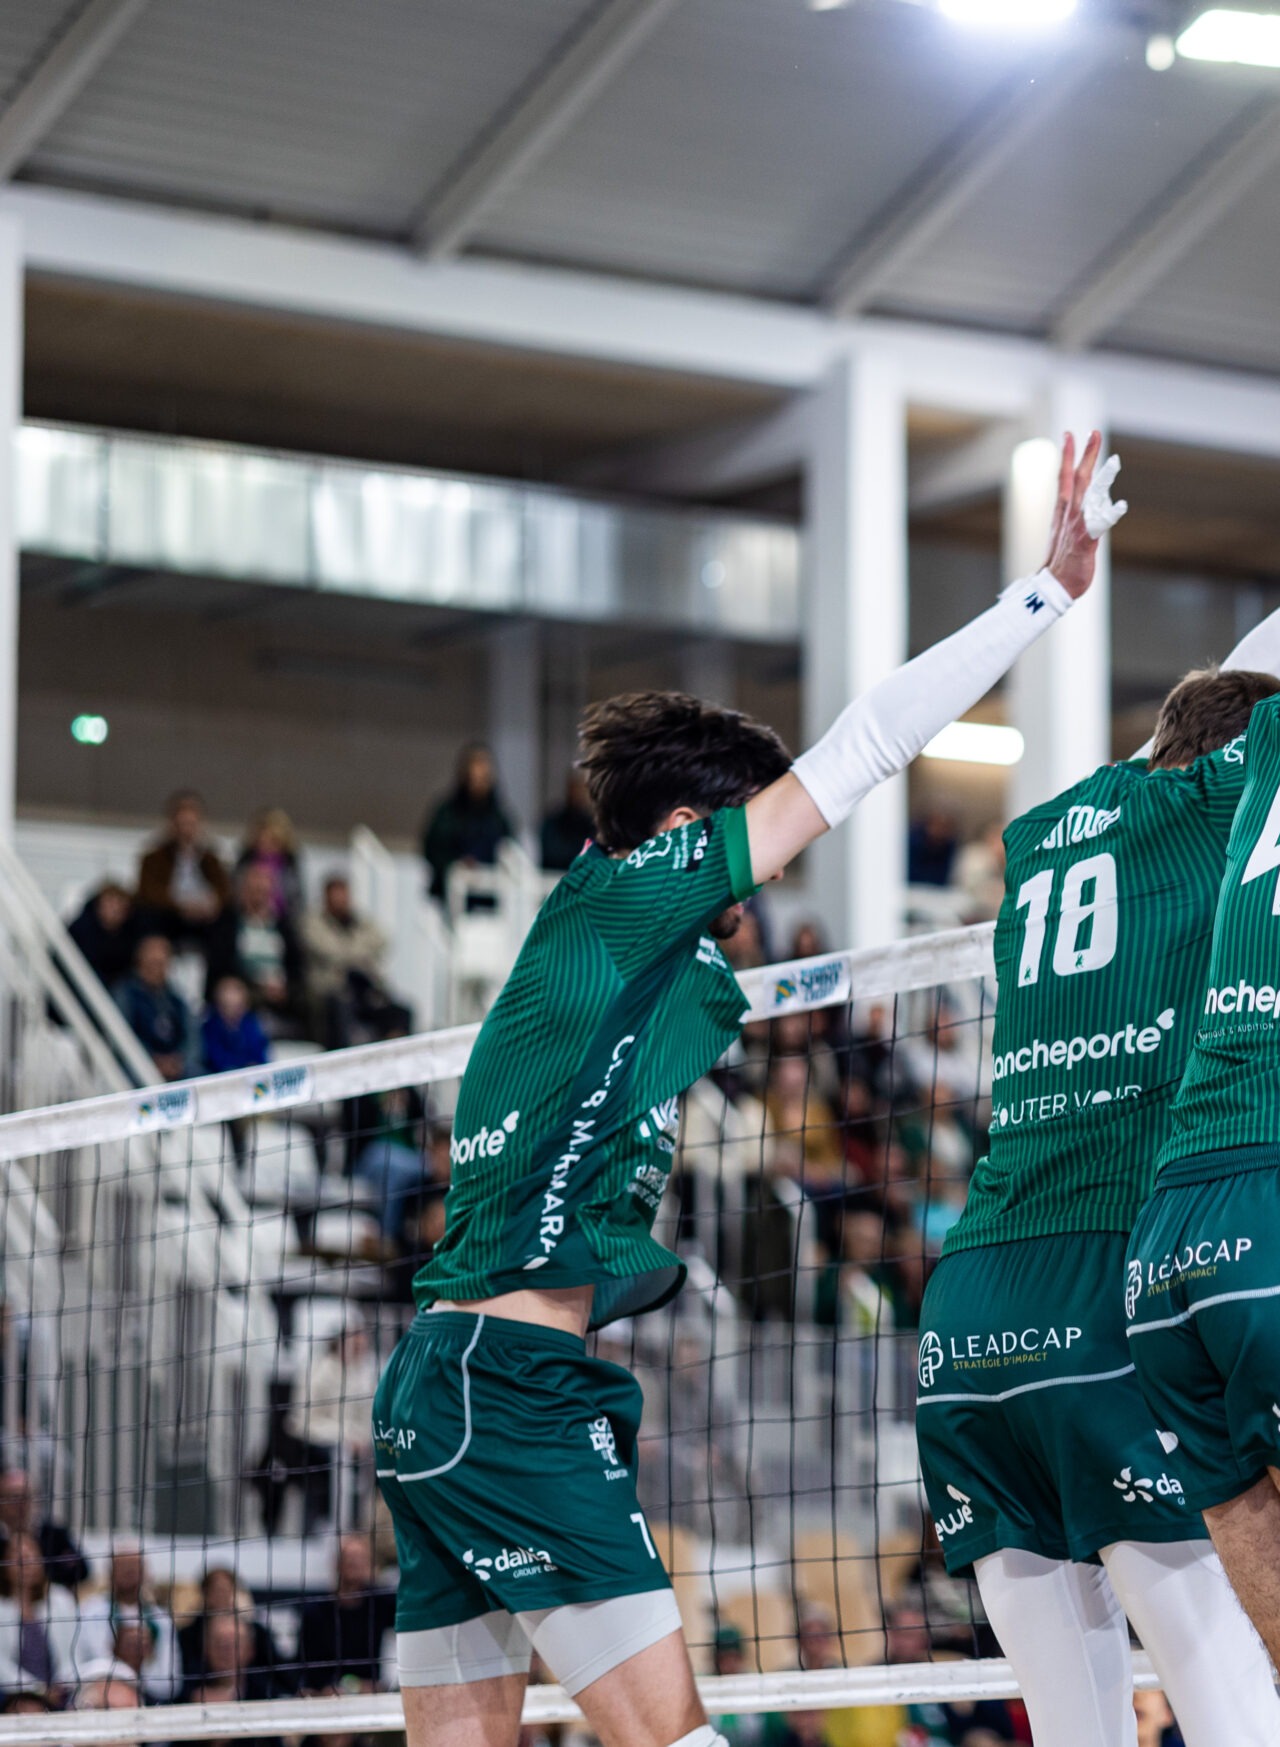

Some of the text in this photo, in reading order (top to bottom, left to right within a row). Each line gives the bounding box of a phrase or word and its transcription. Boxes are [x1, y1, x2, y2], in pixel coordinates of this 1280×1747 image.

[1016, 851, 1119, 989] 18
[1237, 1022, 1275, 1033] AUDITION
[950, 1326, 1082, 1360] LEADCAP
[953, 1351, 1048, 1371] STRATÉGIE D'IMPACT
